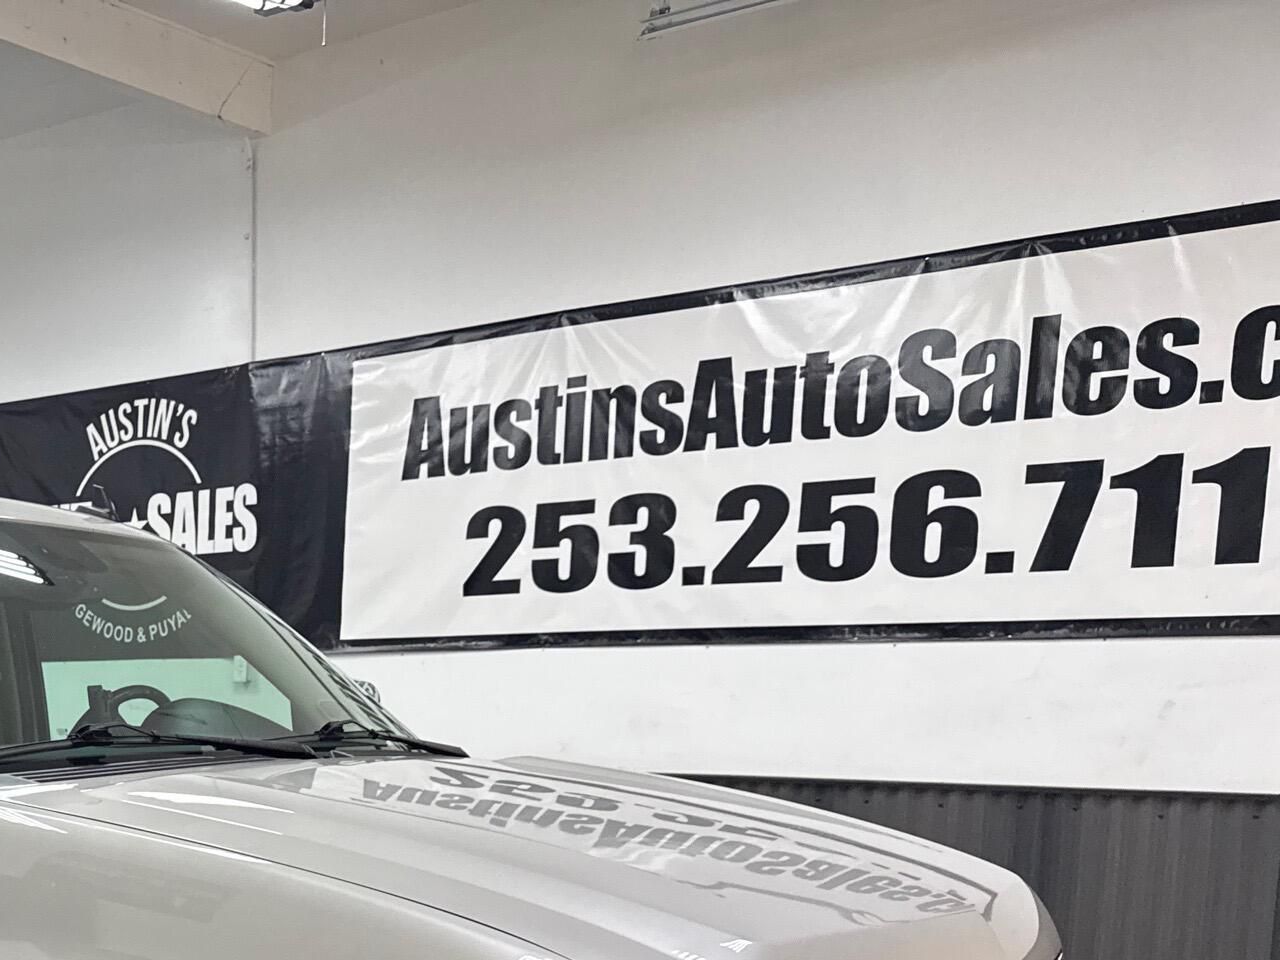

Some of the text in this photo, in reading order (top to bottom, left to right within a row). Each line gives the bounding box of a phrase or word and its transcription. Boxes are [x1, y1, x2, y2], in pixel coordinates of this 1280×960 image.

[85, 397, 198, 461] AUSTIN'S
[401, 304, 1280, 481] AustinsAutoSales.c
[146, 482, 258, 556] SALES
[462, 446, 1271, 597] 253.256.711
[136, 626, 147, 643] &
